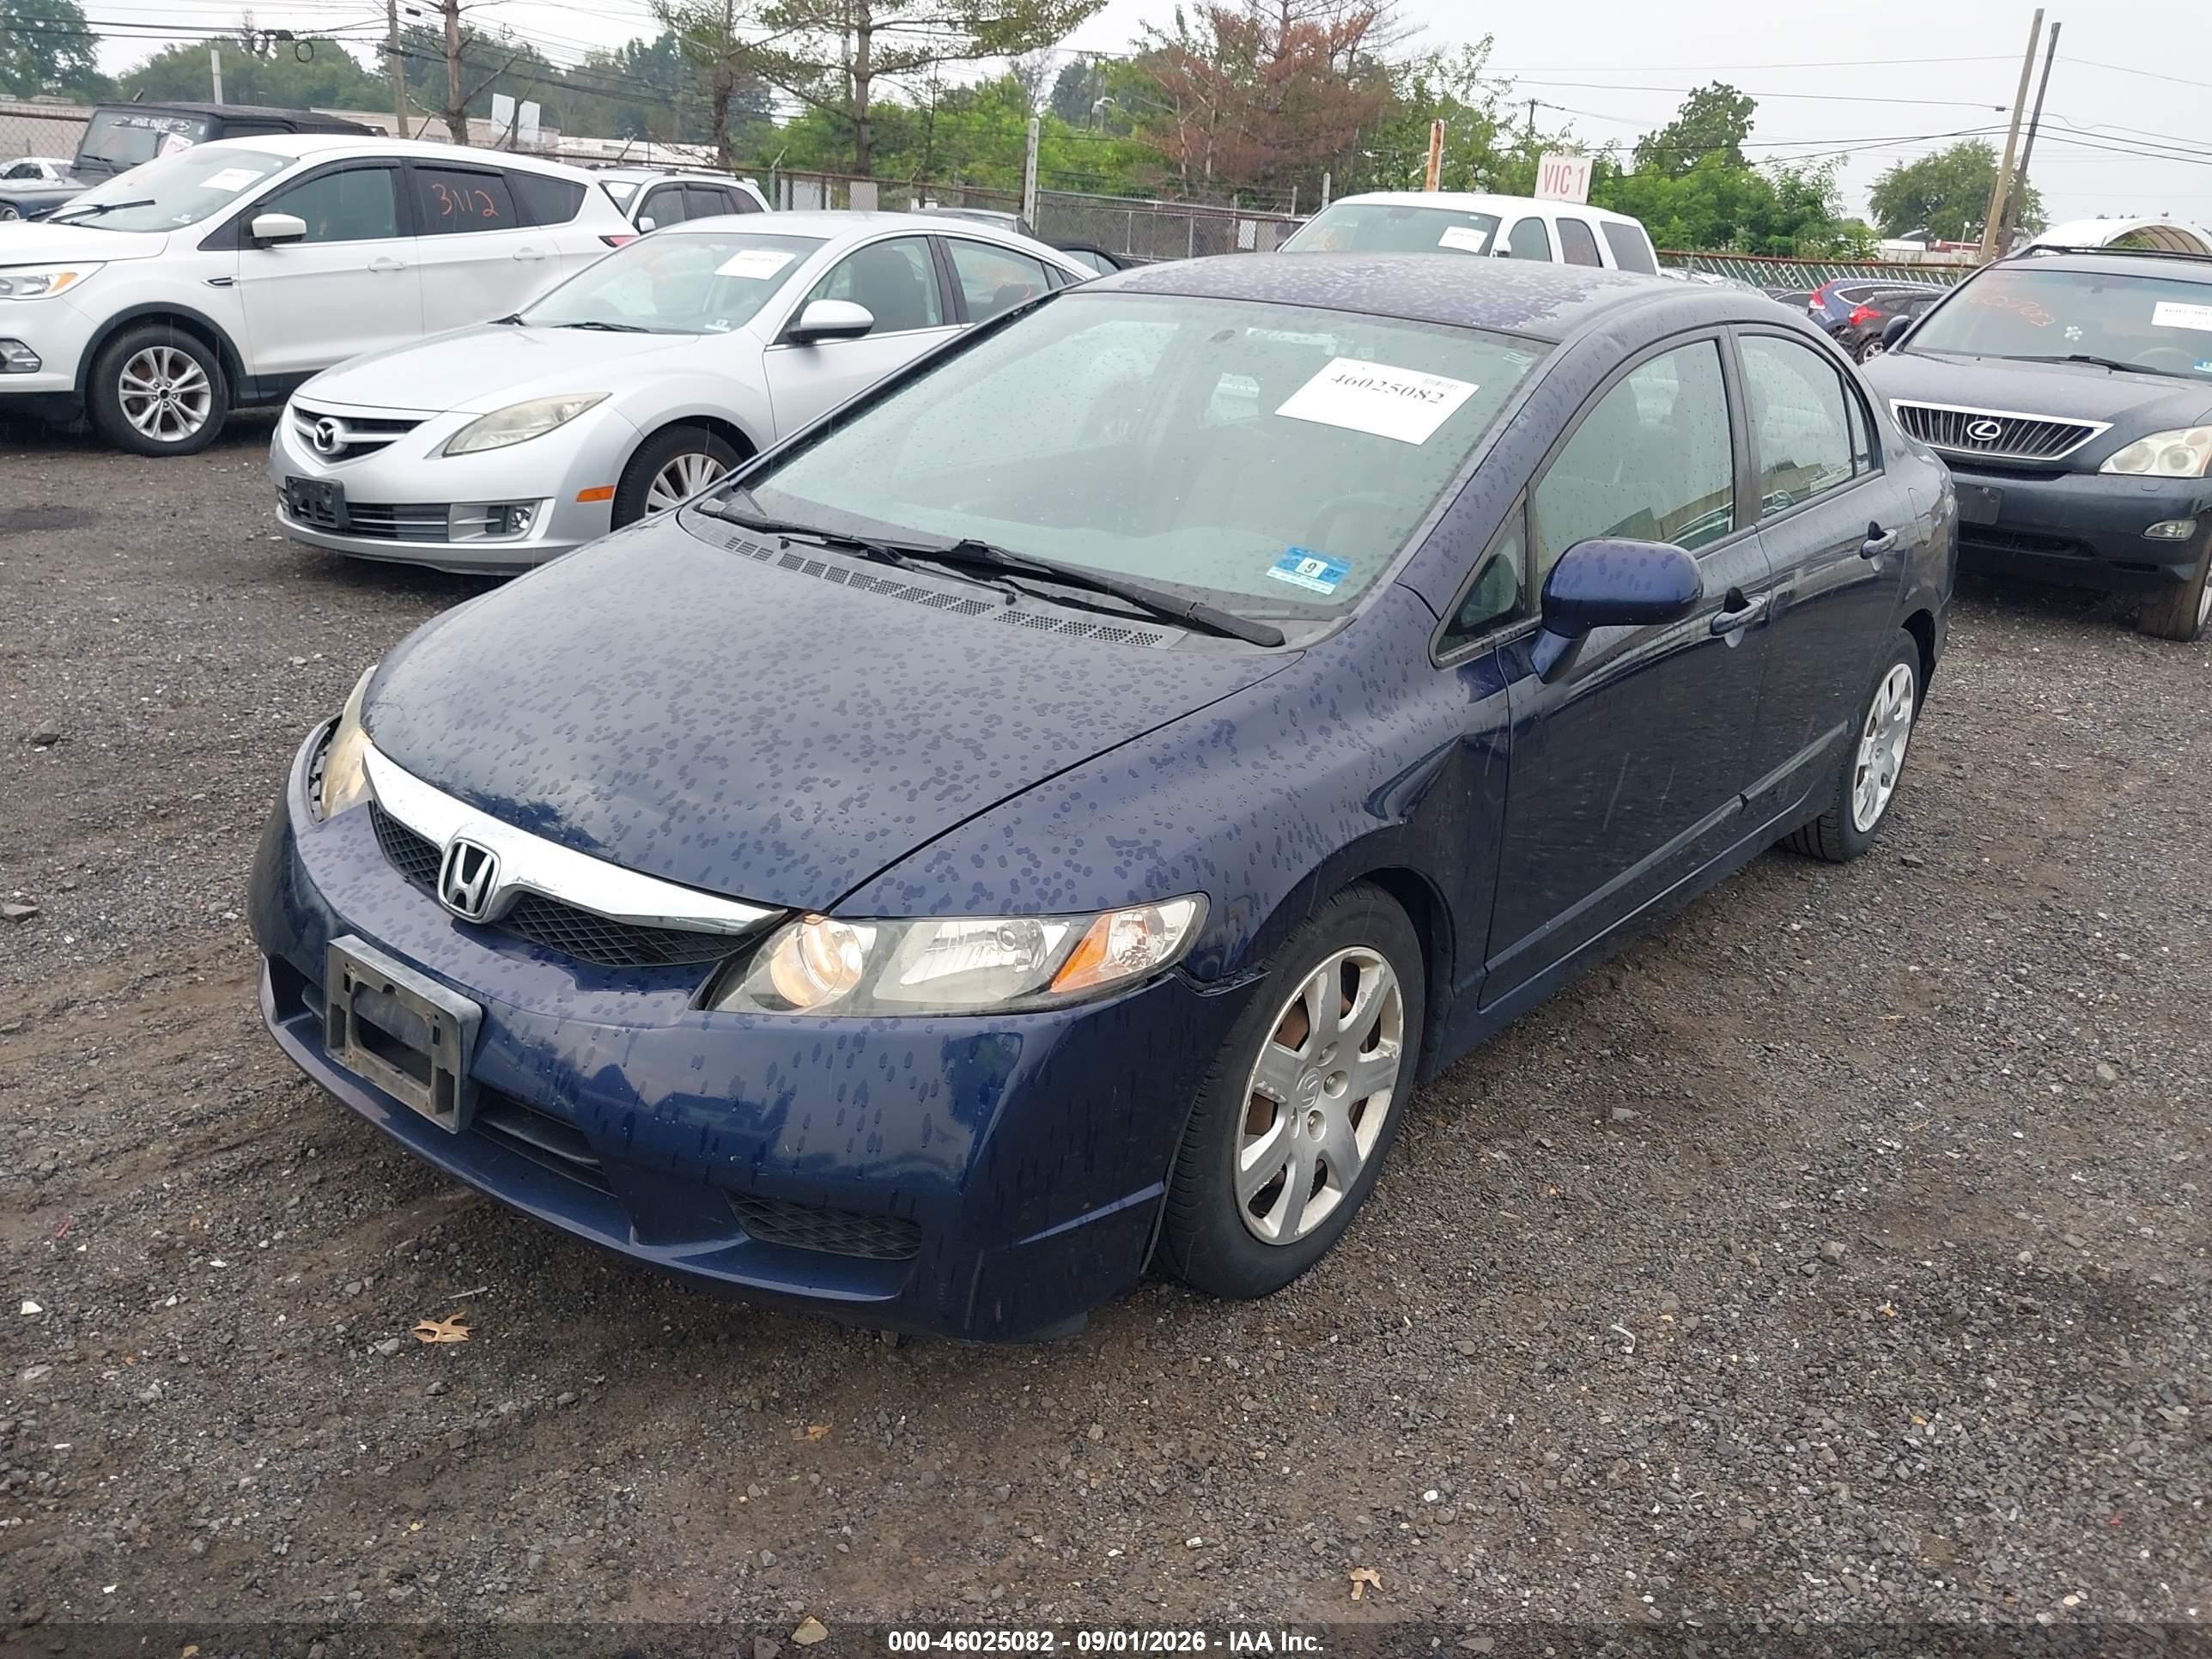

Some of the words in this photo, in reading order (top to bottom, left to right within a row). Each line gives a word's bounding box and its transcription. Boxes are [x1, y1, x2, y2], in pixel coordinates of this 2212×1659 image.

[1544, 164, 1572, 195] VIC
[1577, 166, 1586, 196] 1
[432, 183, 500, 216] 3112
[1330, 374, 1445, 404] 46025082
[1304, 562, 1317, 574] 9
